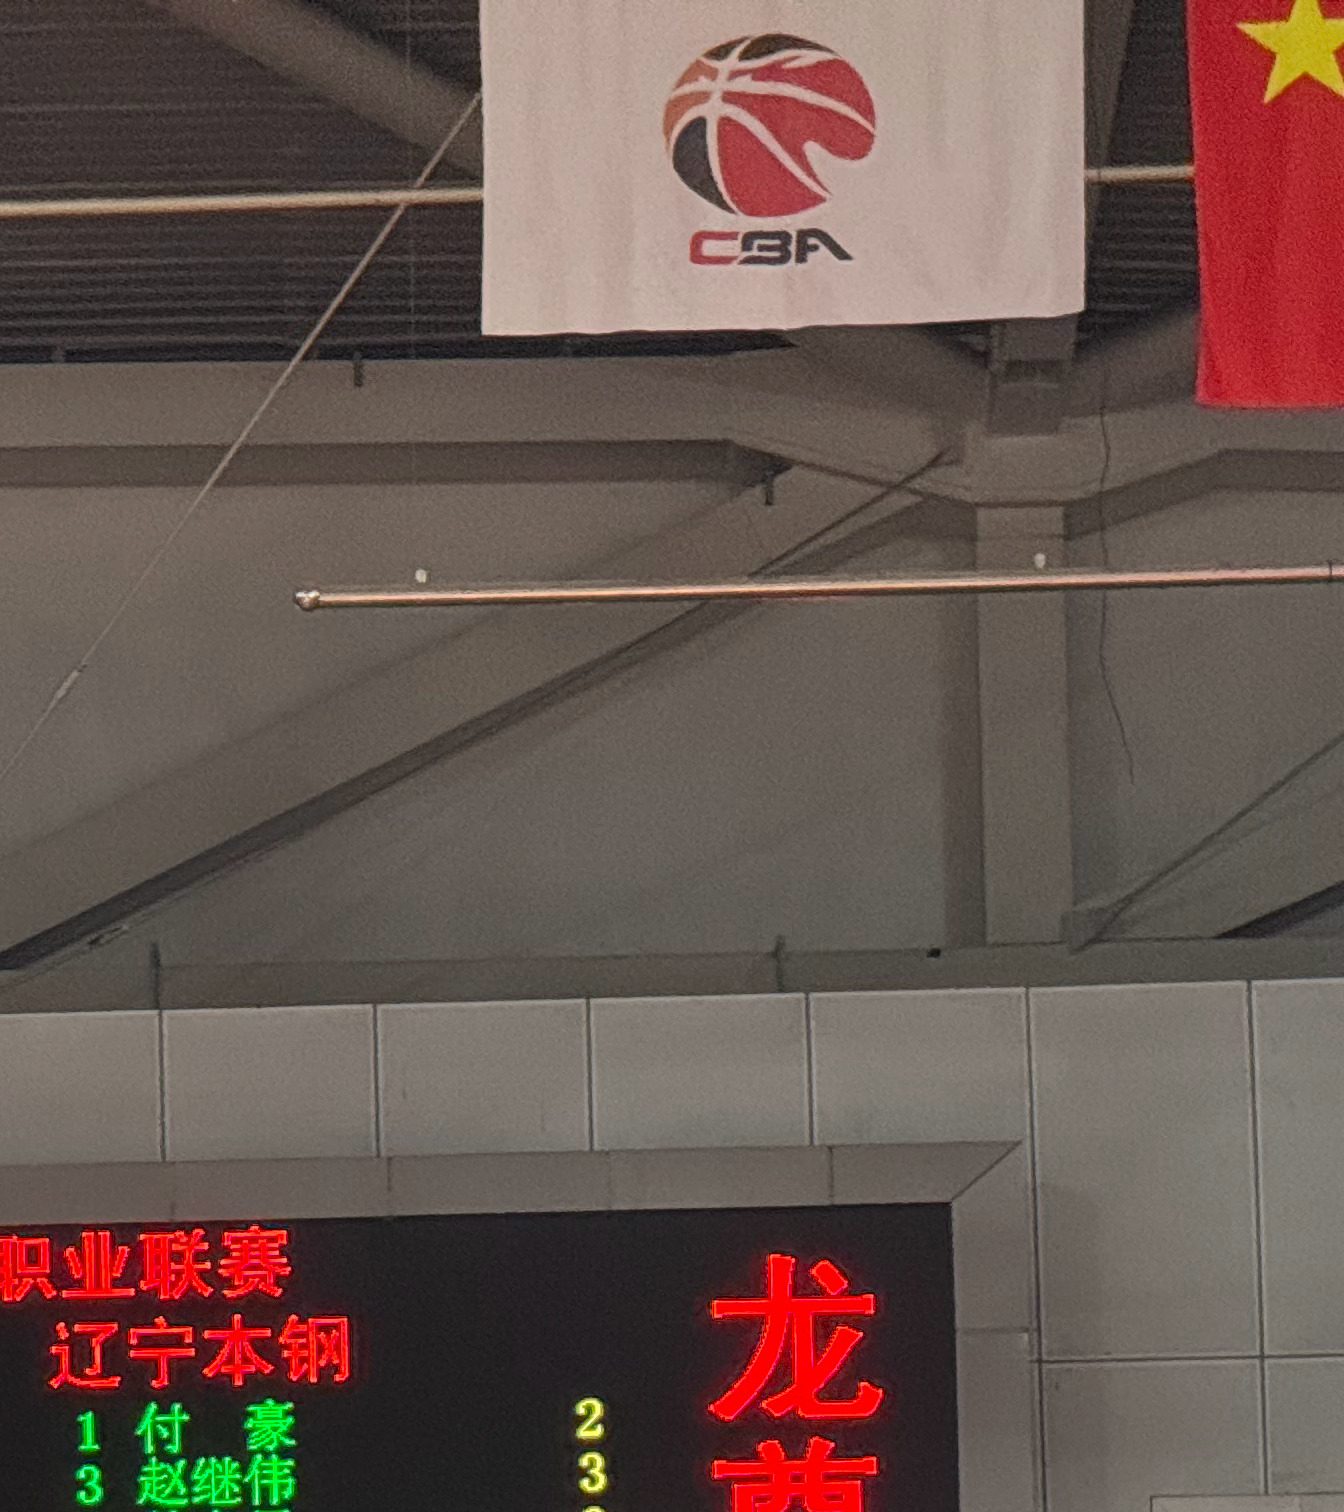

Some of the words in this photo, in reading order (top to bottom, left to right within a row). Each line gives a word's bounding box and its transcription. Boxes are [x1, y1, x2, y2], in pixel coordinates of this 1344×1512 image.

[689, 229, 853, 266] CBA
[50, 1314, 352, 1391] 辽宁本钢
[77, 1411, 101, 1452] 1
[576, 1398, 606, 1441] 2
[75, 1464, 103, 1505] 3
[137, 1454, 295, 1506] 赵继伟
[580, 1452, 609, 1495] 3
